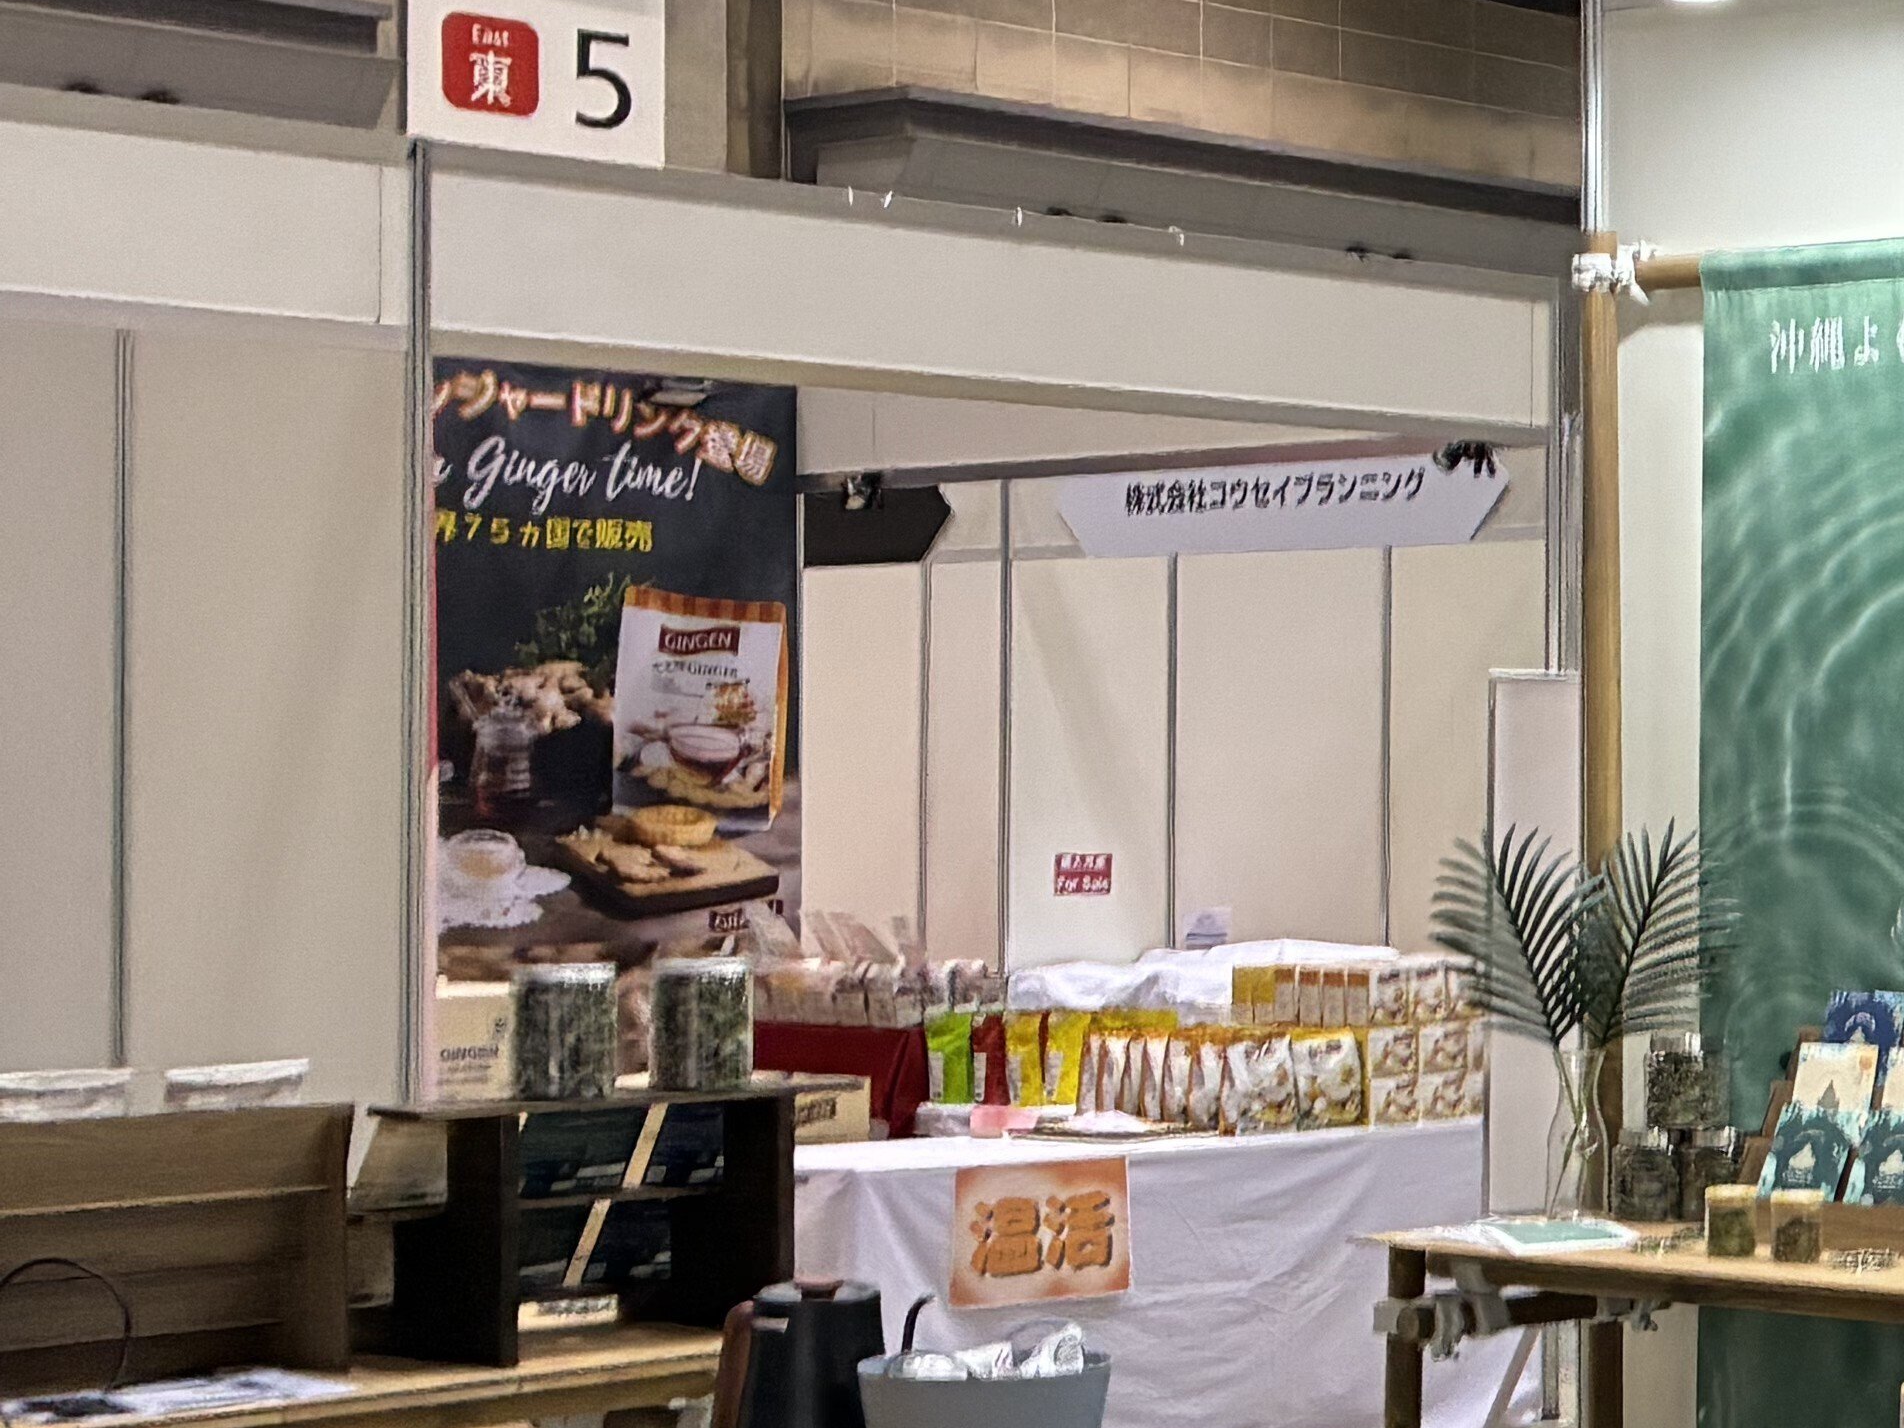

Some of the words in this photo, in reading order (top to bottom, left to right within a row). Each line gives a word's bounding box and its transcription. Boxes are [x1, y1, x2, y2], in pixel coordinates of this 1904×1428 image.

[469, 49, 513, 108] 東
[575, 28, 632, 130] 5
[463, 436, 598, 515] Ginger
[601, 439, 703, 502] time!
[664, 629, 733, 652] GINGEN
[970, 1188, 1116, 1277] 温活
